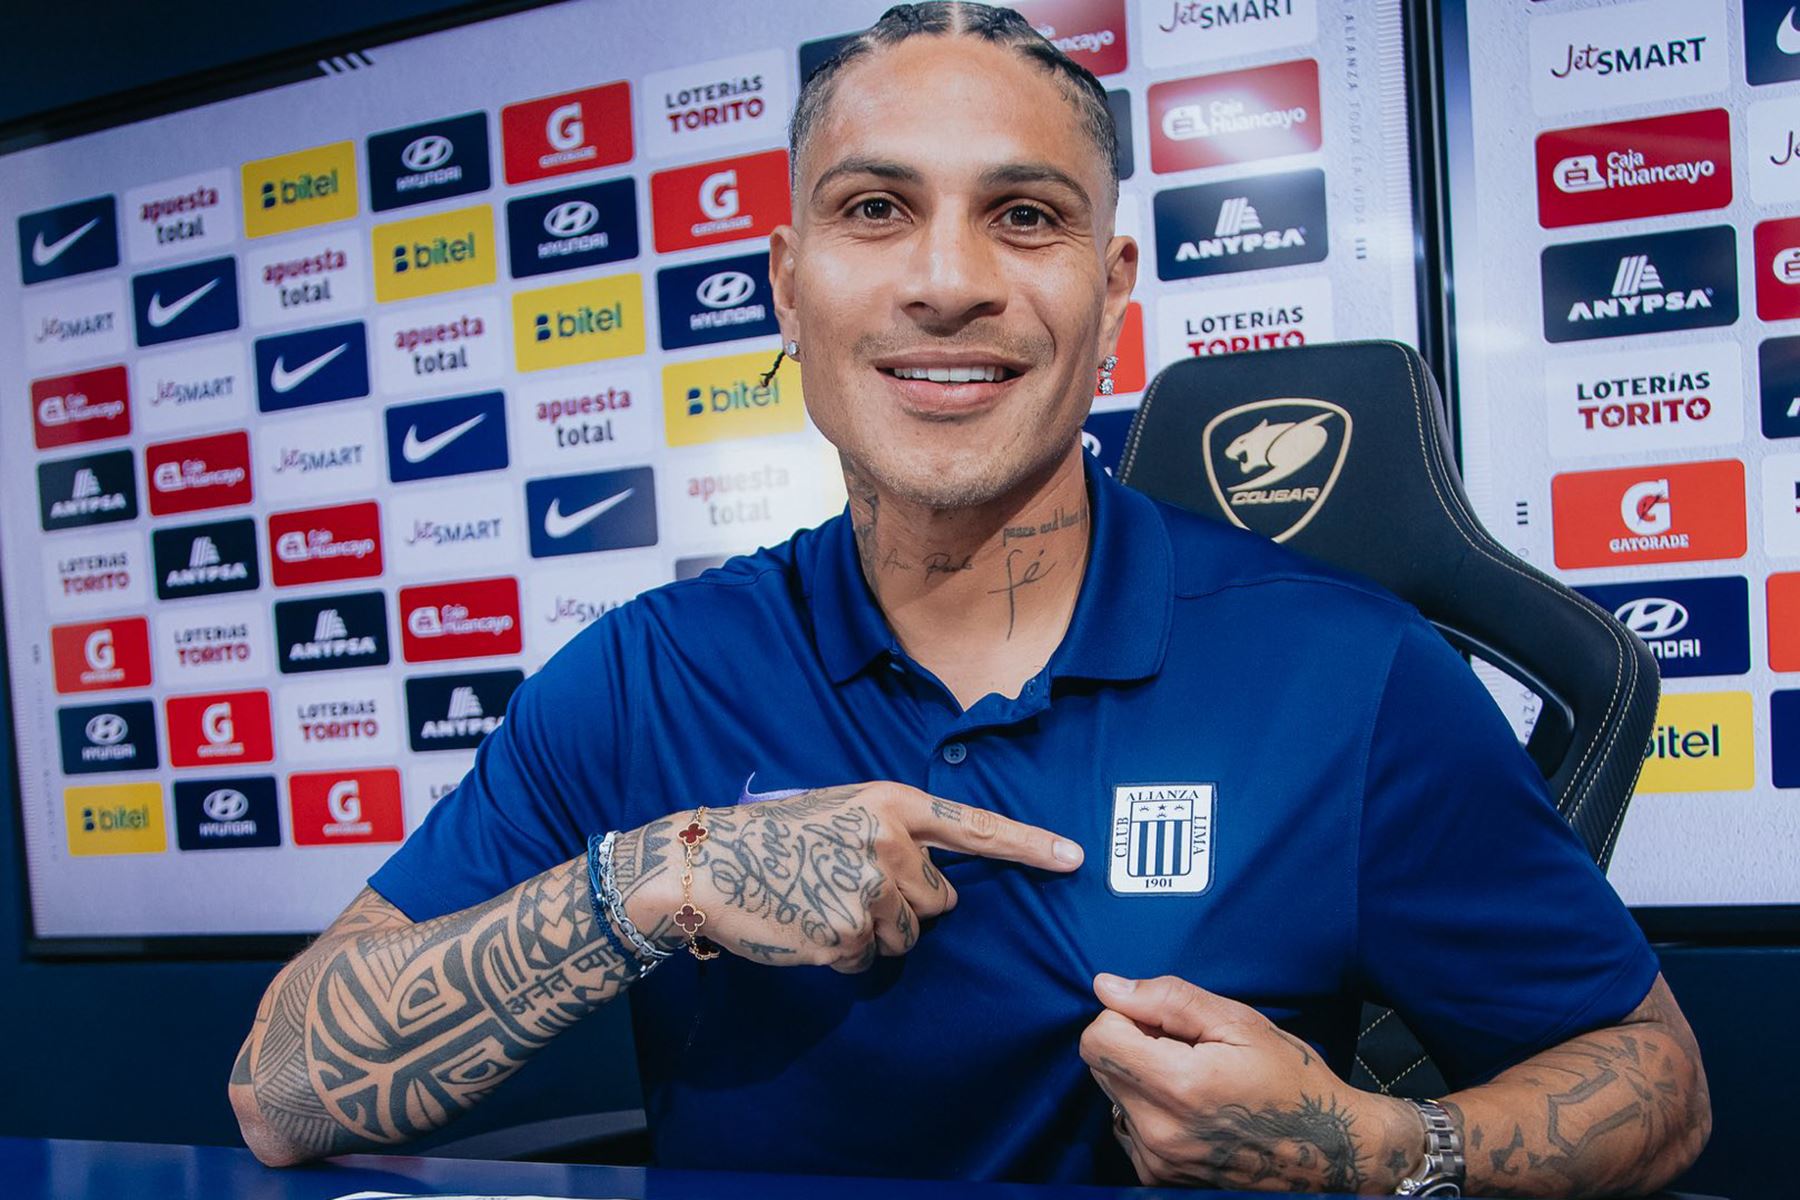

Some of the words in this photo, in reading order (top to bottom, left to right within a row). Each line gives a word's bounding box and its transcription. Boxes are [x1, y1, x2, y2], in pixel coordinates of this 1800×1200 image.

[1551, 36, 1706, 78] JetSMART
[667, 97, 765, 135] TORITO
[1210, 107, 1308, 136] Huancayo
[1607, 149, 1644, 171] Caja
[1607, 159, 1715, 189] Huancayo
[280, 168, 339, 205] bitel
[139, 186, 219, 223] apuesta
[156, 217, 204, 245] total
[1175, 227, 1306, 262] ANYPSA
[262, 249, 348, 285] apuesta
[414, 233, 476, 269] bitel
[279, 277, 331, 308] total
[1567, 288, 1712, 322] ANYPSA
[393, 315, 485, 350] apuesta
[558, 302, 623, 338] bitel
[413, 346, 468, 376] total
[536, 385, 632, 424] apuesta
[711, 378, 780, 412] bitel
[1578, 396, 1711, 429] TORITO
[556, 419, 614, 448] total
[687, 464, 790, 501] apuesta
[1229, 486, 1320, 507] COUGAR
[709, 497, 772, 527] total
[1620, 478, 1672, 535] G
[1608, 533, 1690, 554] GATORADE
[1648, 638, 1701, 660] NDAI
[1126, 789, 1200, 801] ALIANZA
[1114, 816, 1129, 858] CLUB
[1192, 815, 1207, 856] LIMA
[1145, 877, 1173, 889] 1901
